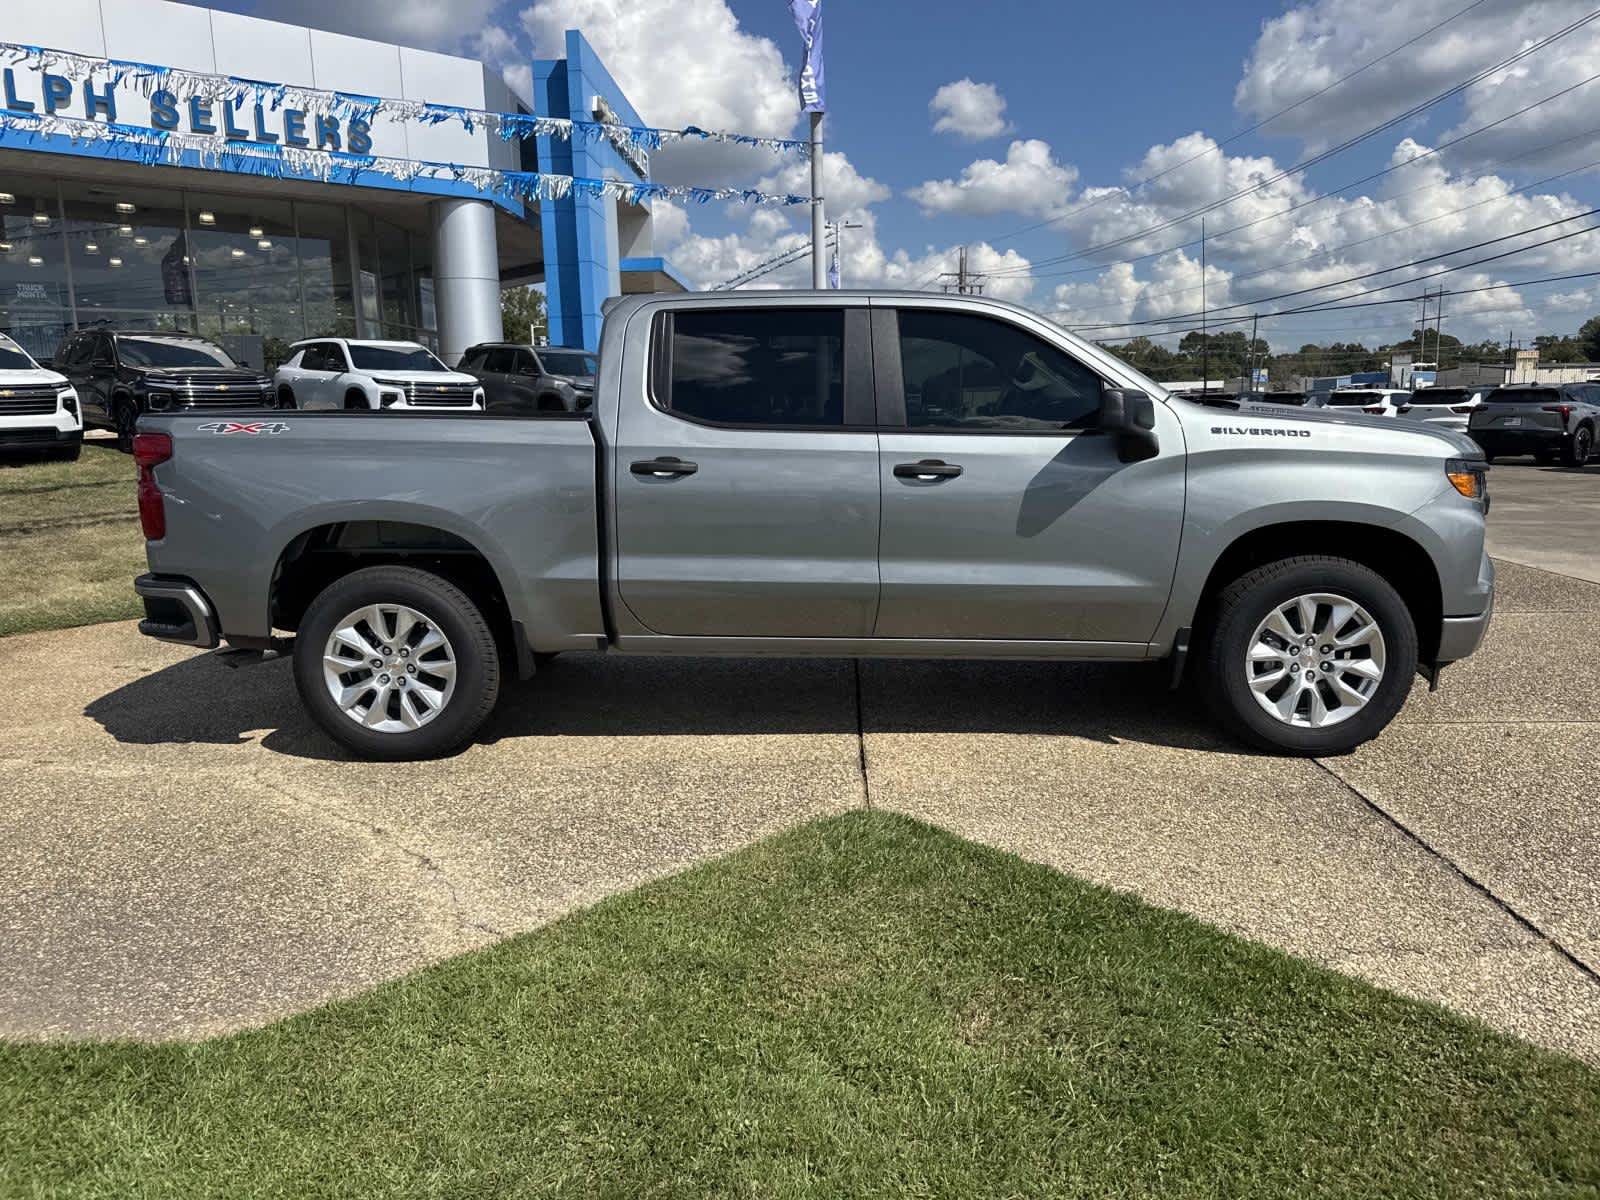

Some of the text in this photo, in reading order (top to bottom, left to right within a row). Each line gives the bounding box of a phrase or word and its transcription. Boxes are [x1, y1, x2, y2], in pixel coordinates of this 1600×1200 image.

[149, 88, 373, 154] SELLERS
[16, 283, 45, 291] TRUCK
[16, 290, 48, 298] MONTH
[1210, 426, 1312, 438] SILVERADO
